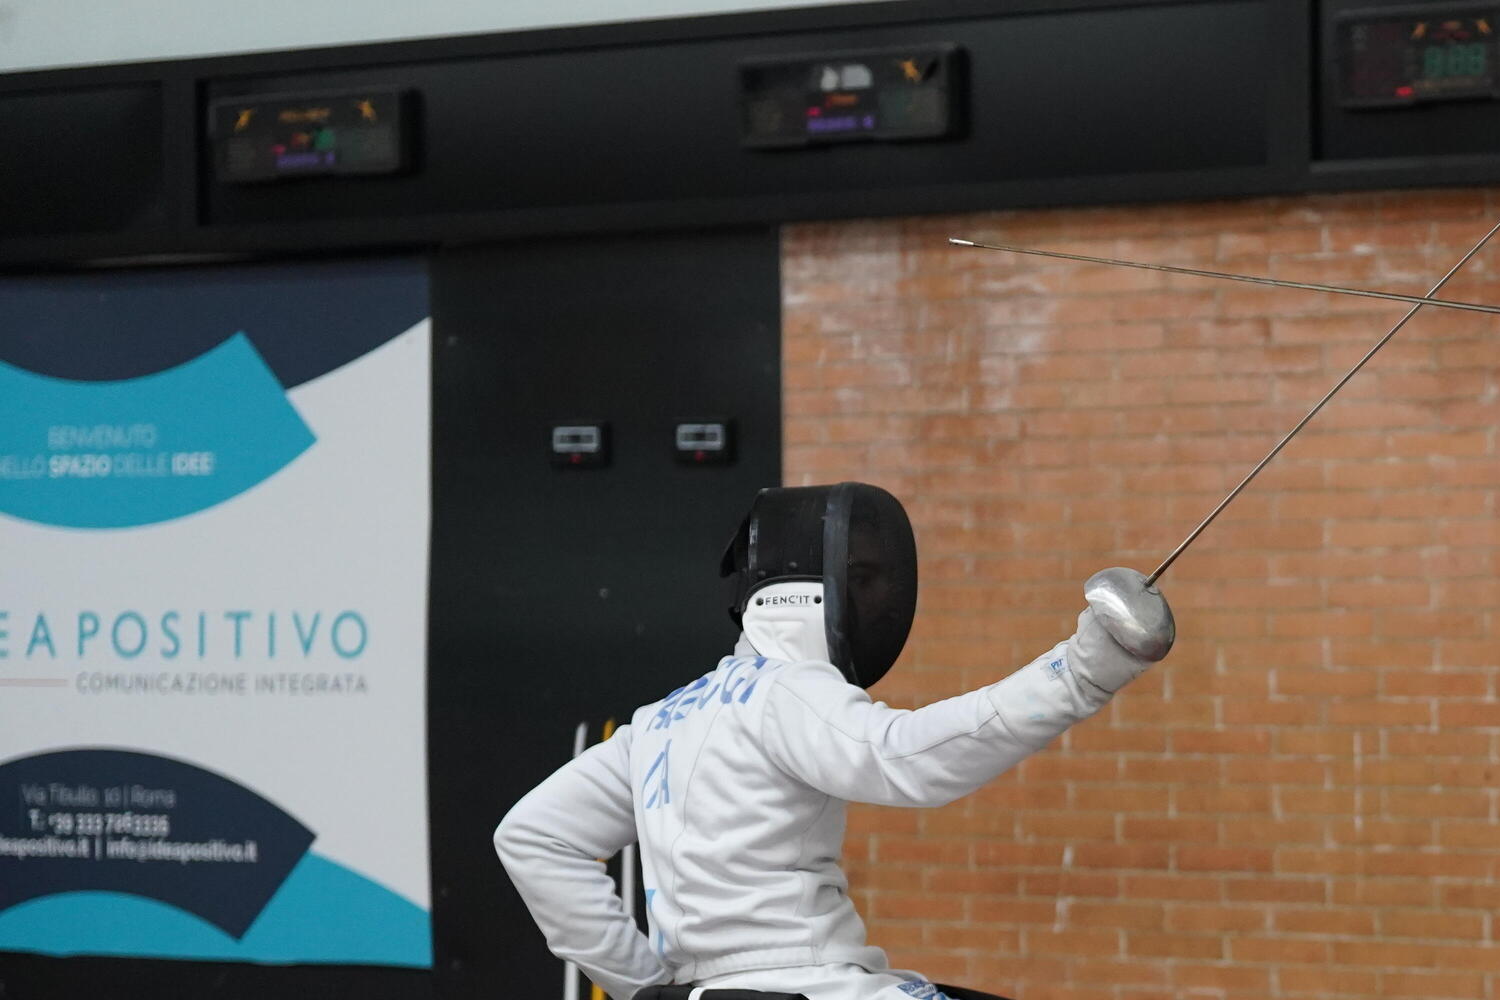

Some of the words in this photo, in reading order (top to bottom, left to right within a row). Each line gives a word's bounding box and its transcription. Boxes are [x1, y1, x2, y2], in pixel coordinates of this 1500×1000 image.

[49, 453, 112, 478] SPAZIO
[113, 452, 168, 477] DELLE
[171, 451, 214, 476] IDEE
[765, 594, 811, 606] FENC'IT
[76, 672, 247, 695] COMUNICAZIONE
[255, 674, 369, 694] INTEGRATA
